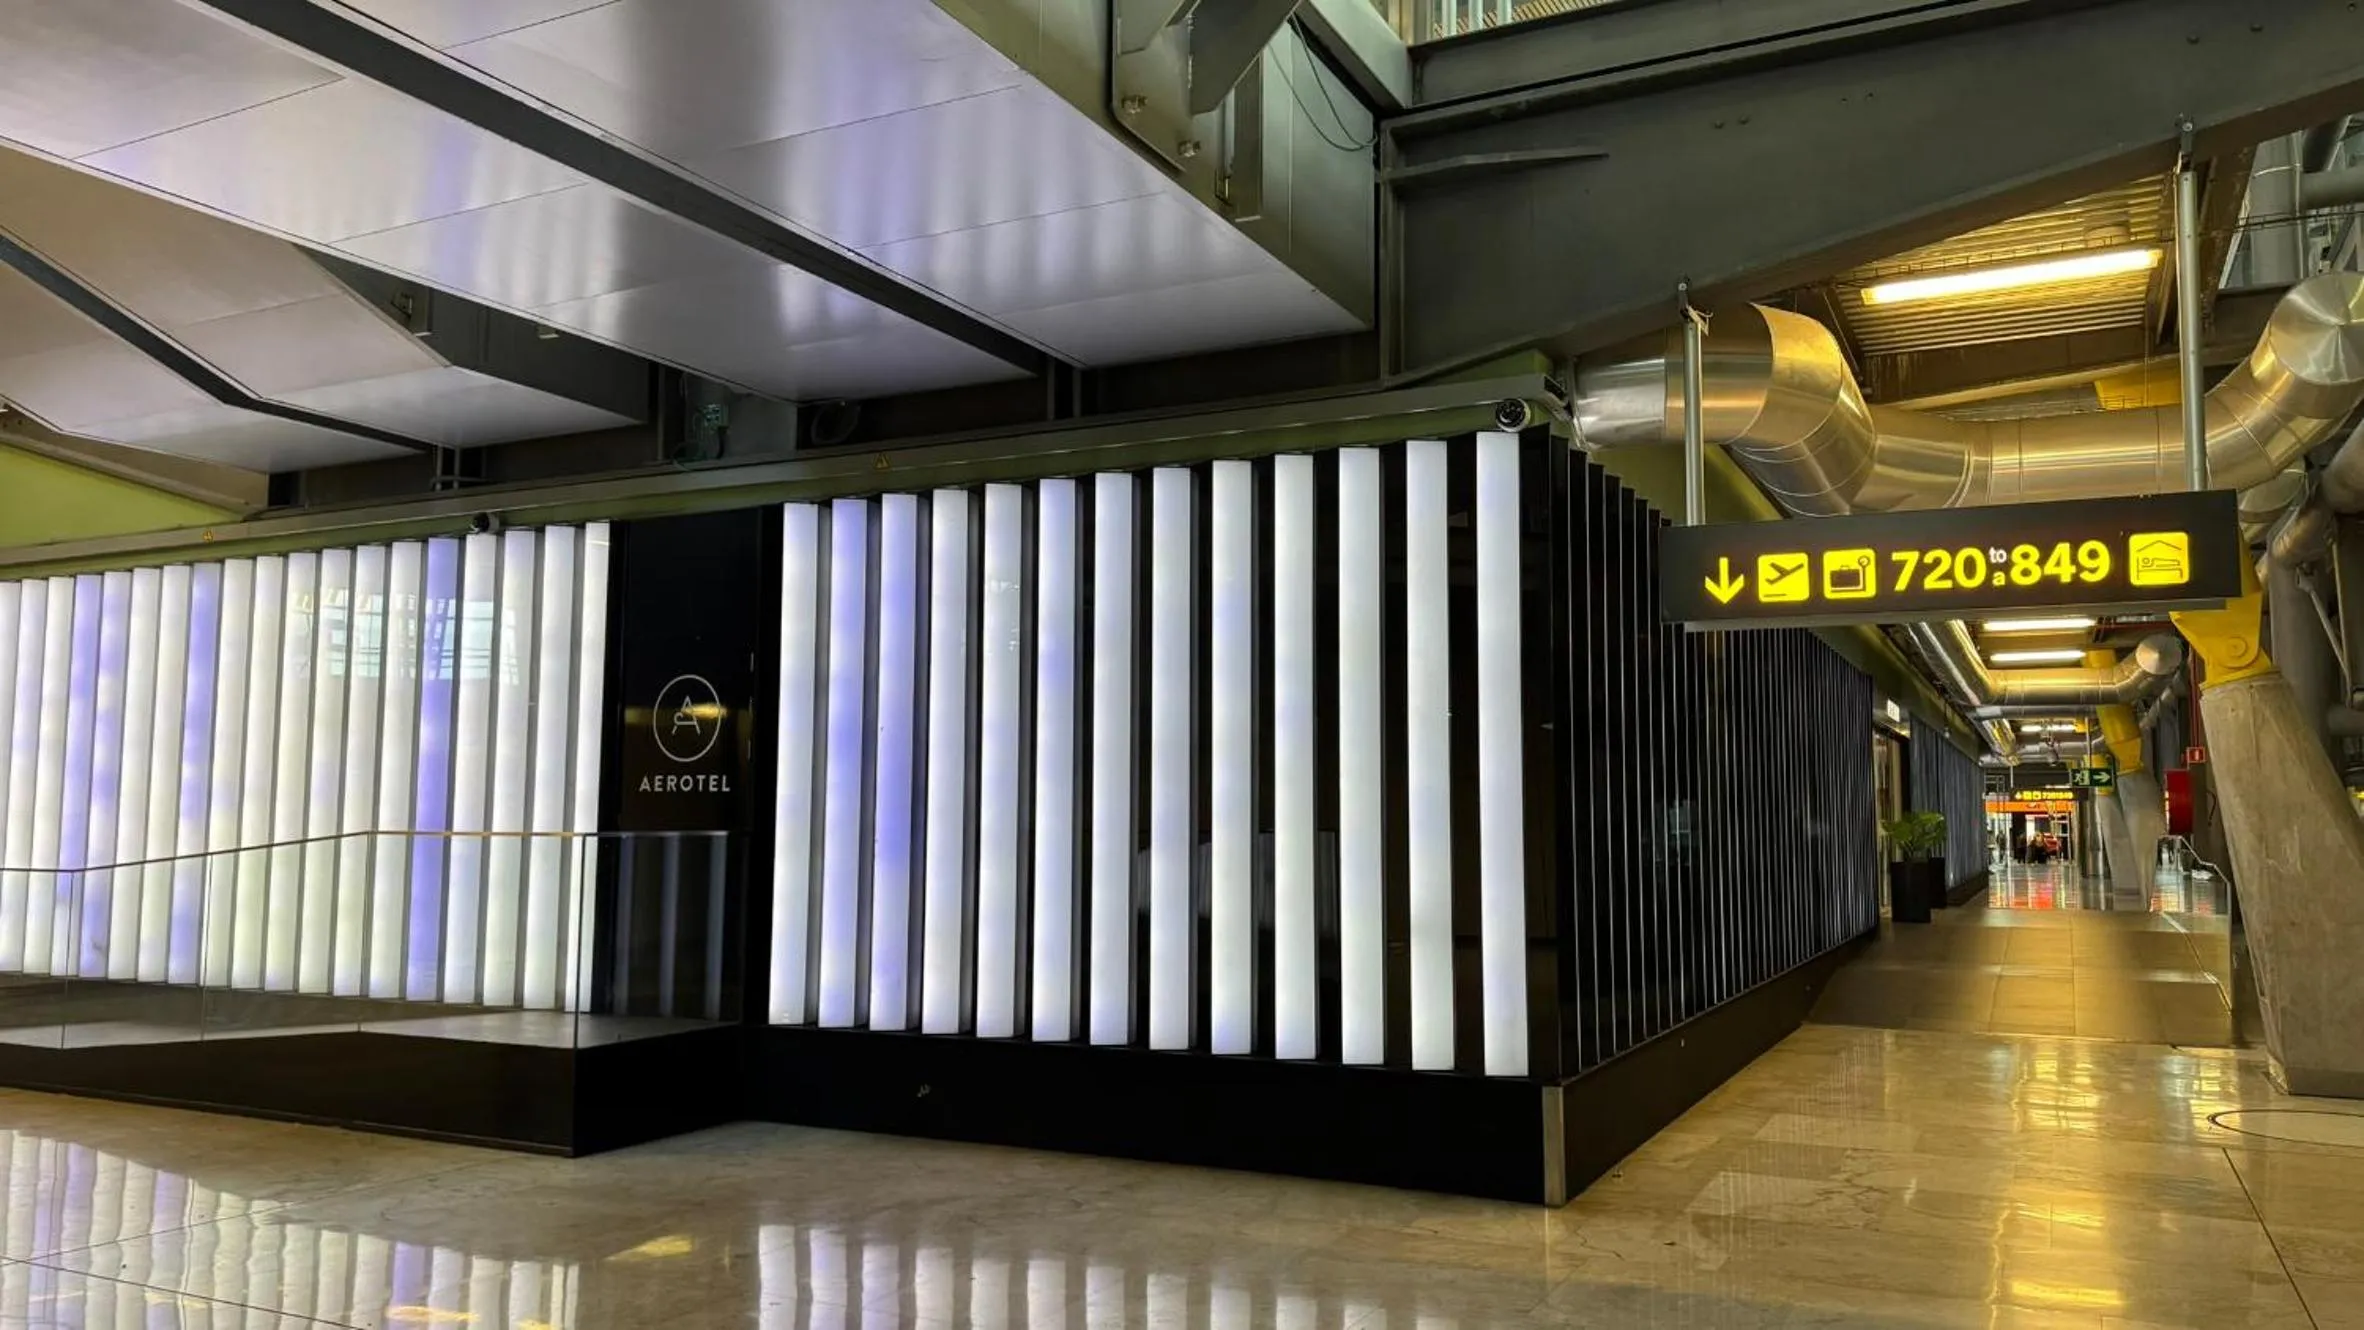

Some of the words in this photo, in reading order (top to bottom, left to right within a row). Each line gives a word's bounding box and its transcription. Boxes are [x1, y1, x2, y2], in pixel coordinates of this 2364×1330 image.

[1989, 546, 2007, 563] to
[2010, 539, 2111, 586] 849
[1891, 547, 1987, 591] 720
[1992, 571, 2006, 586] a
[639, 774, 731, 792] AEROTEL
